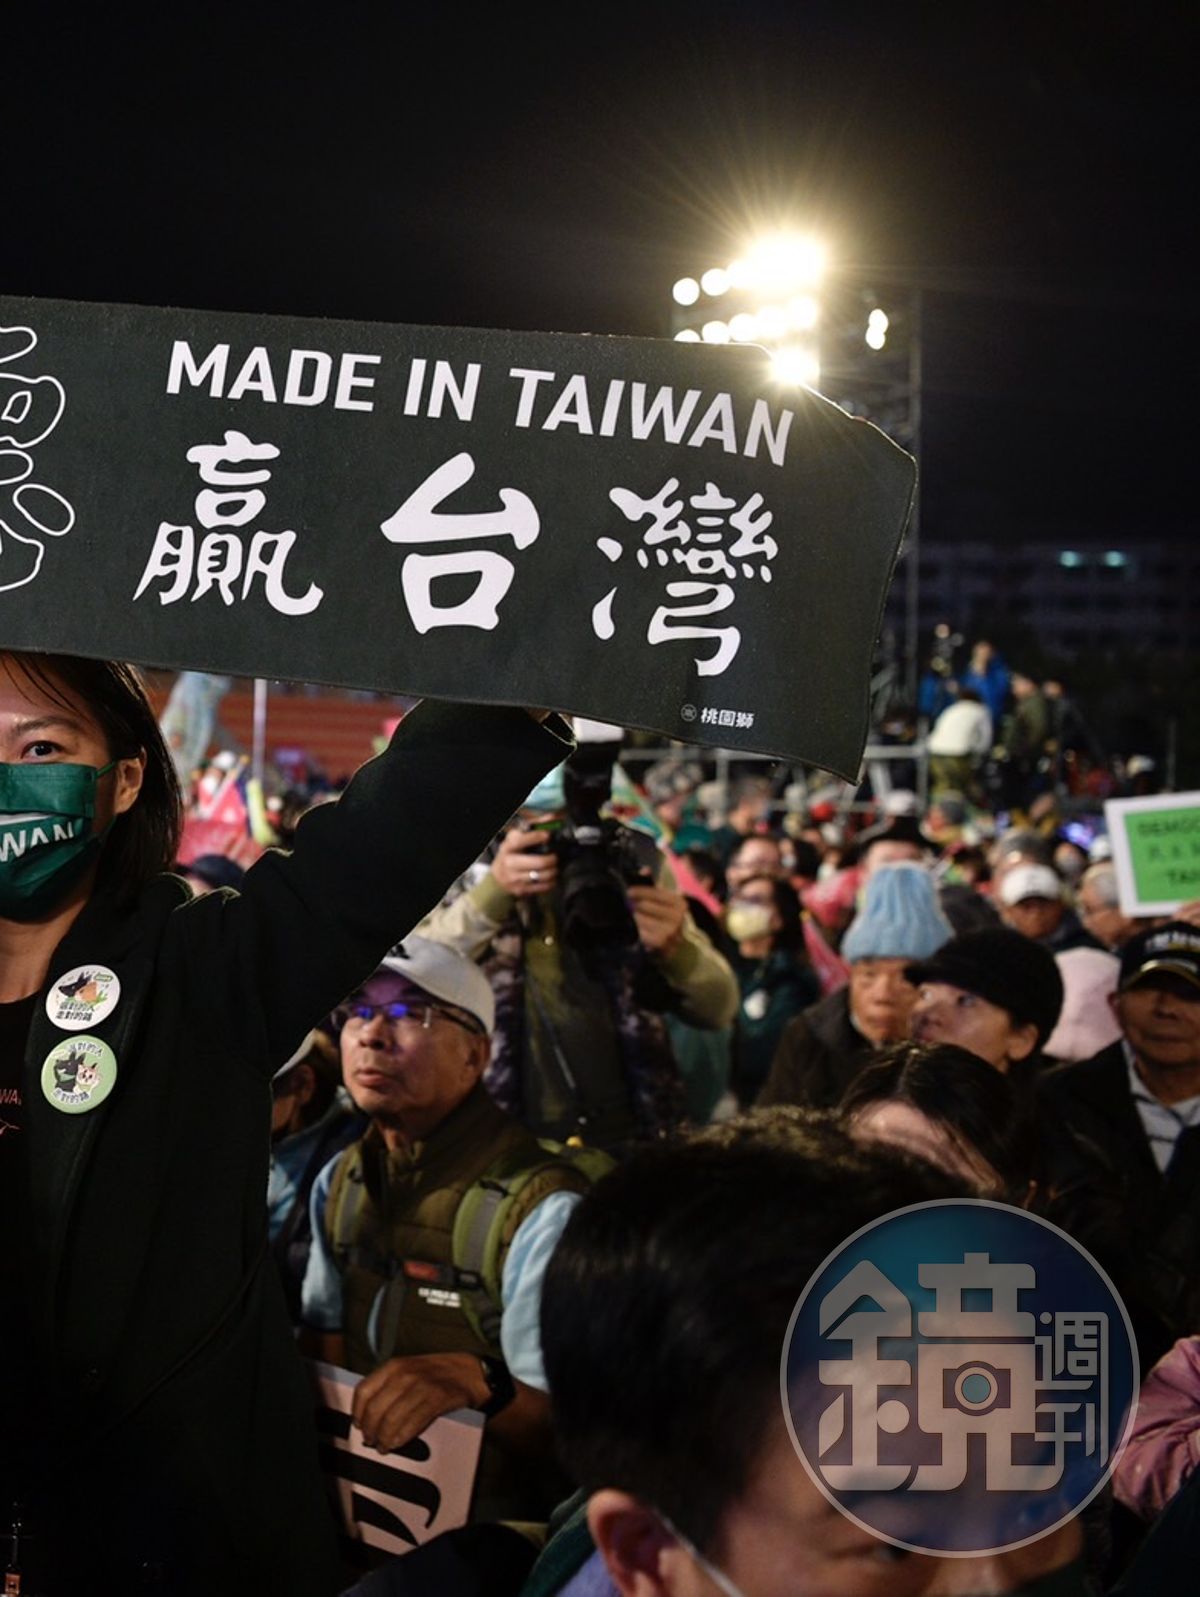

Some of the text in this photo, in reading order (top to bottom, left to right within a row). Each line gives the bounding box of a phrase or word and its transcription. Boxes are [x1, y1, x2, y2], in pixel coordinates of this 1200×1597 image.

[166, 340, 794, 467] MADE IN TAIWAN
[133, 430, 778, 677] 贏台灣
